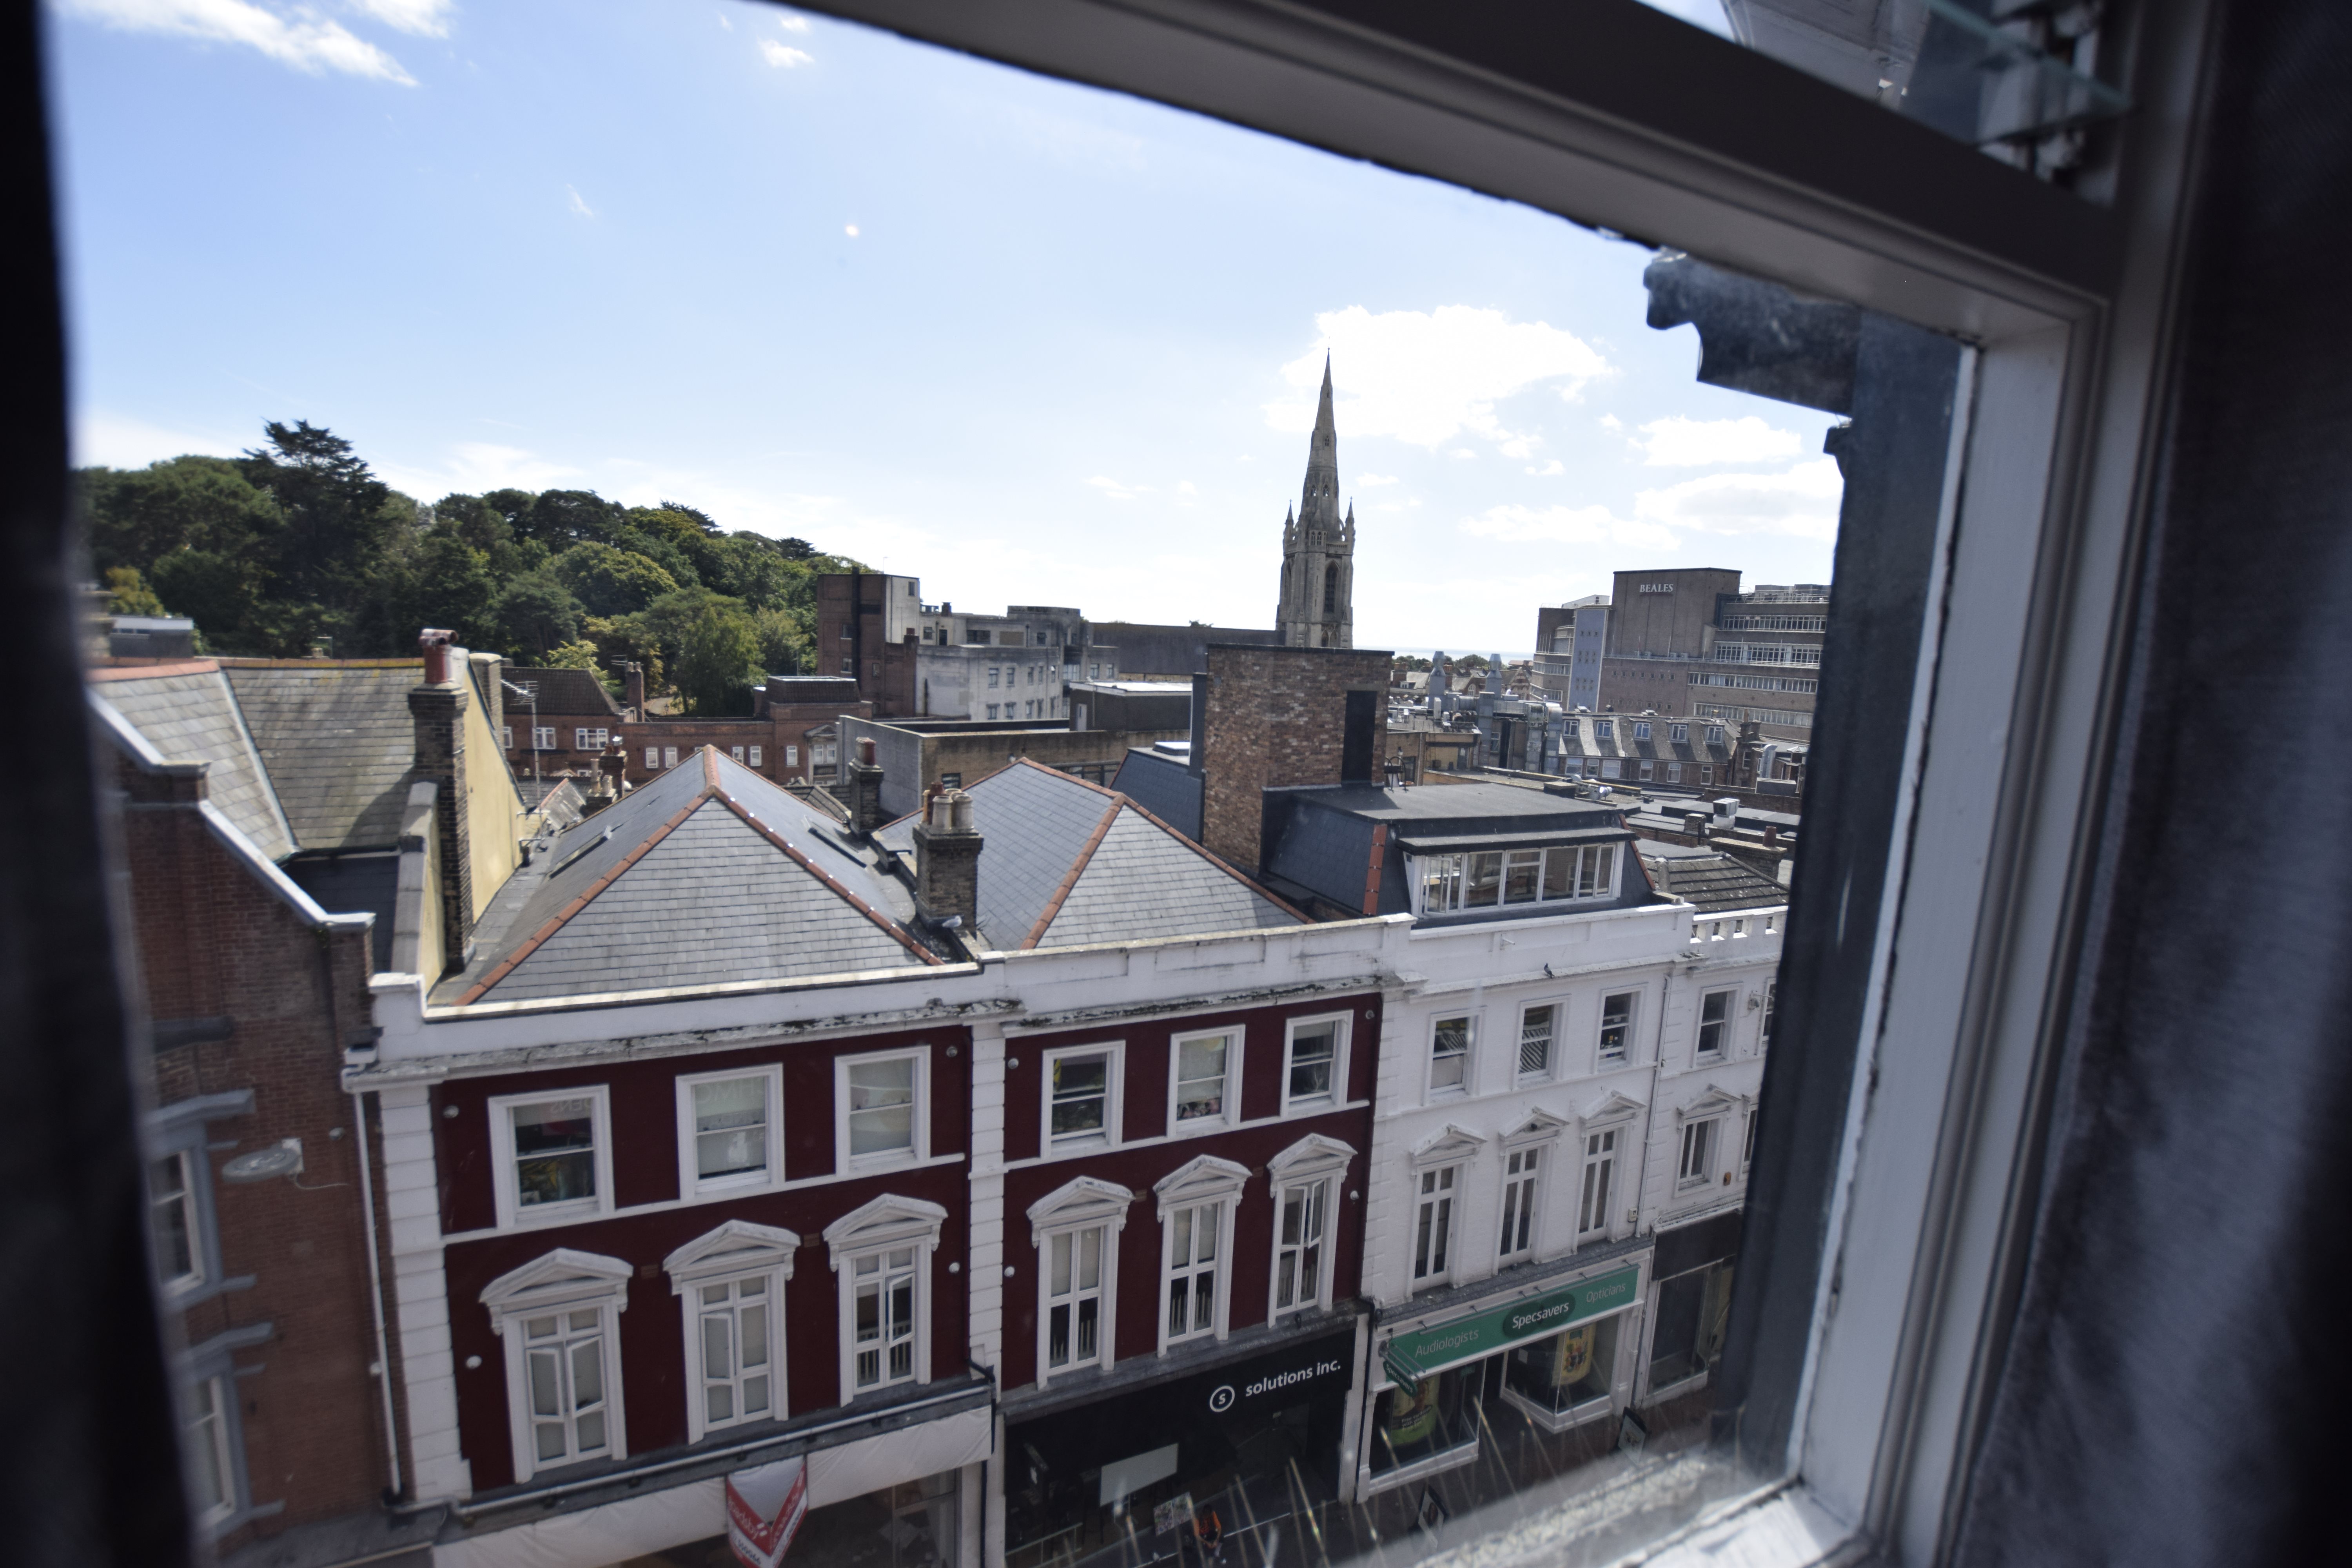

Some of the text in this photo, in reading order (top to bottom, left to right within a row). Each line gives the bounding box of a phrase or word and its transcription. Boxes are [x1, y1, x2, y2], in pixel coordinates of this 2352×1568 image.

[1640, 584, 1673, 592] BEALES
[1415, 1283, 1626, 1358] Audiologists Specsavers Opticians
[1245, 1367, 1313, 1397] solutions
[1317, 1359, 1341, 1376] inc.
[1386, 1363, 1413, 1393] Specsavers
